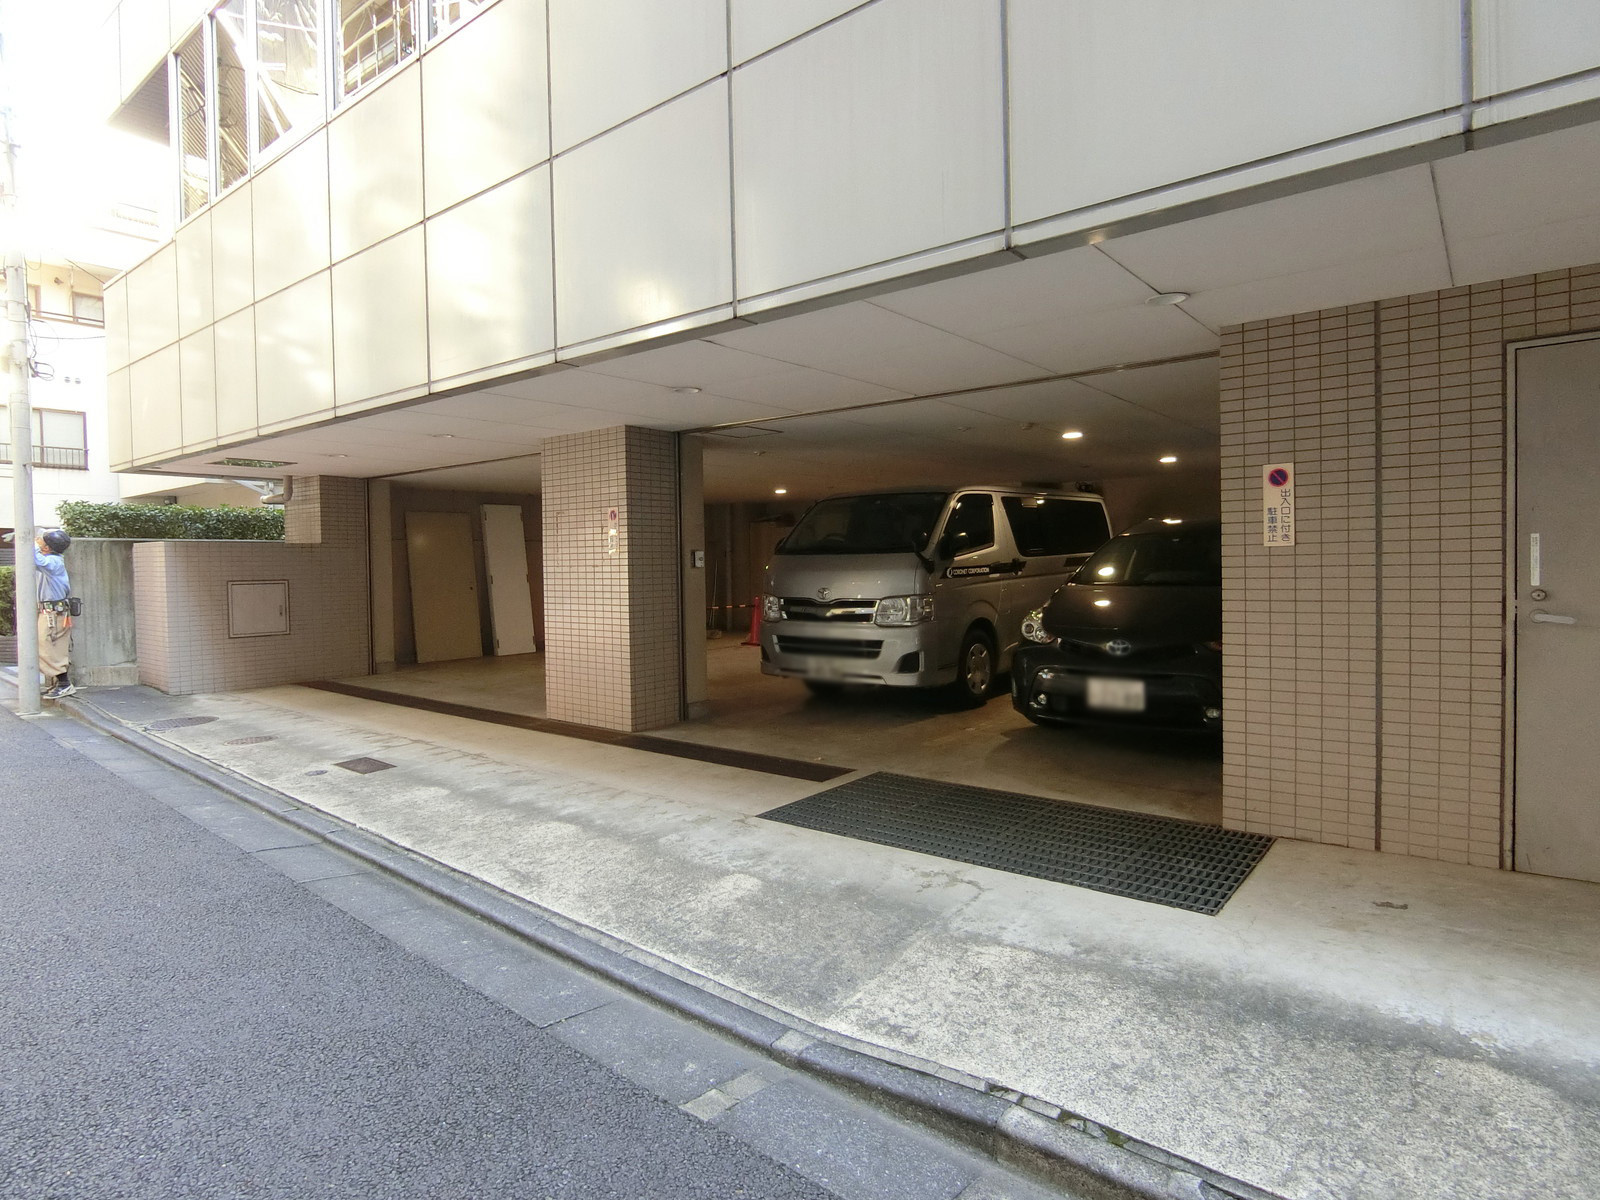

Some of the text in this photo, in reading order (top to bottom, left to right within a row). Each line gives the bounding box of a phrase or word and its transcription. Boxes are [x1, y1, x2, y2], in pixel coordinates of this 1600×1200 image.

[1267, 507, 1278, 542] 駐車禁止
[1280, 488, 1291, 542] 出入口に付き
